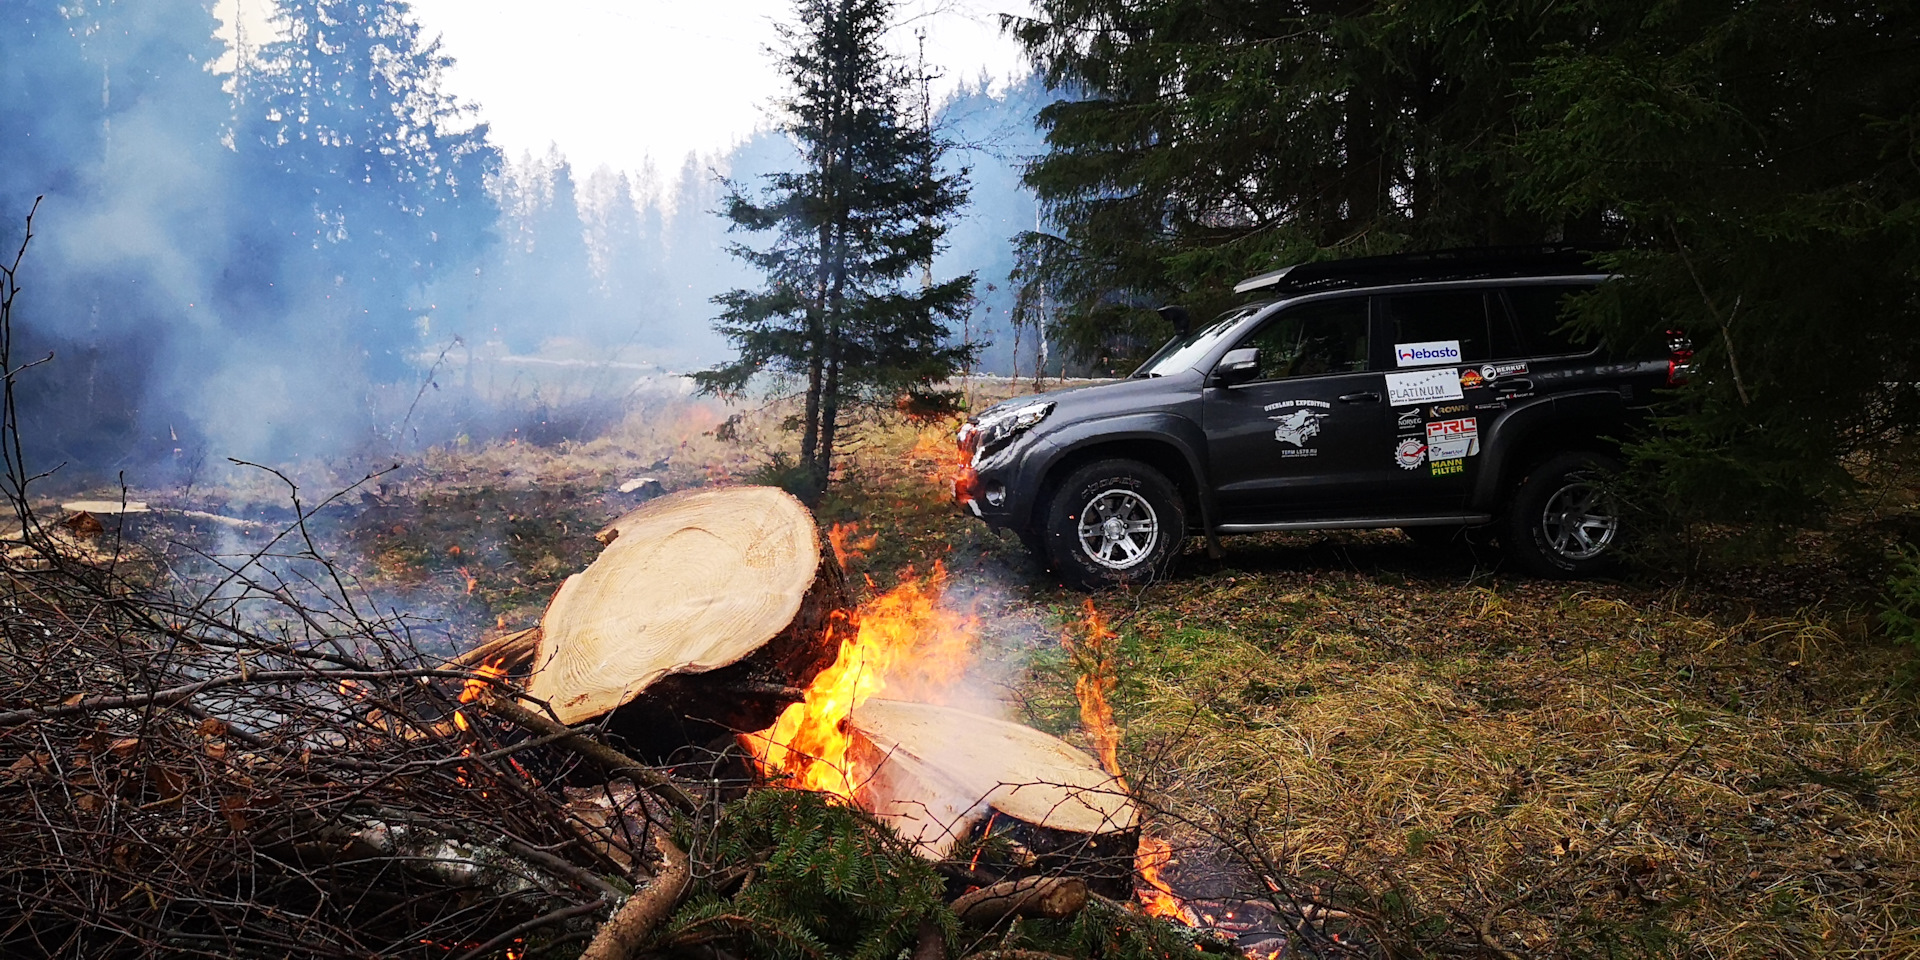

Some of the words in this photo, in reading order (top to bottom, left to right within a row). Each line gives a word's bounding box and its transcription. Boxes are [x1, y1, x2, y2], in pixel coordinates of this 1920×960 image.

[1398, 347, 1458, 360] Webasto
[1496, 364, 1526, 373] BERKUT
[1390, 386, 1445, 399] PLATINUM
[1264, 400, 1295, 412] OVERLAND
[1295, 400, 1331, 409] EXPEDITION
[1431, 458, 1463, 468] MANN
[1432, 465, 1464, 475] FILTER
